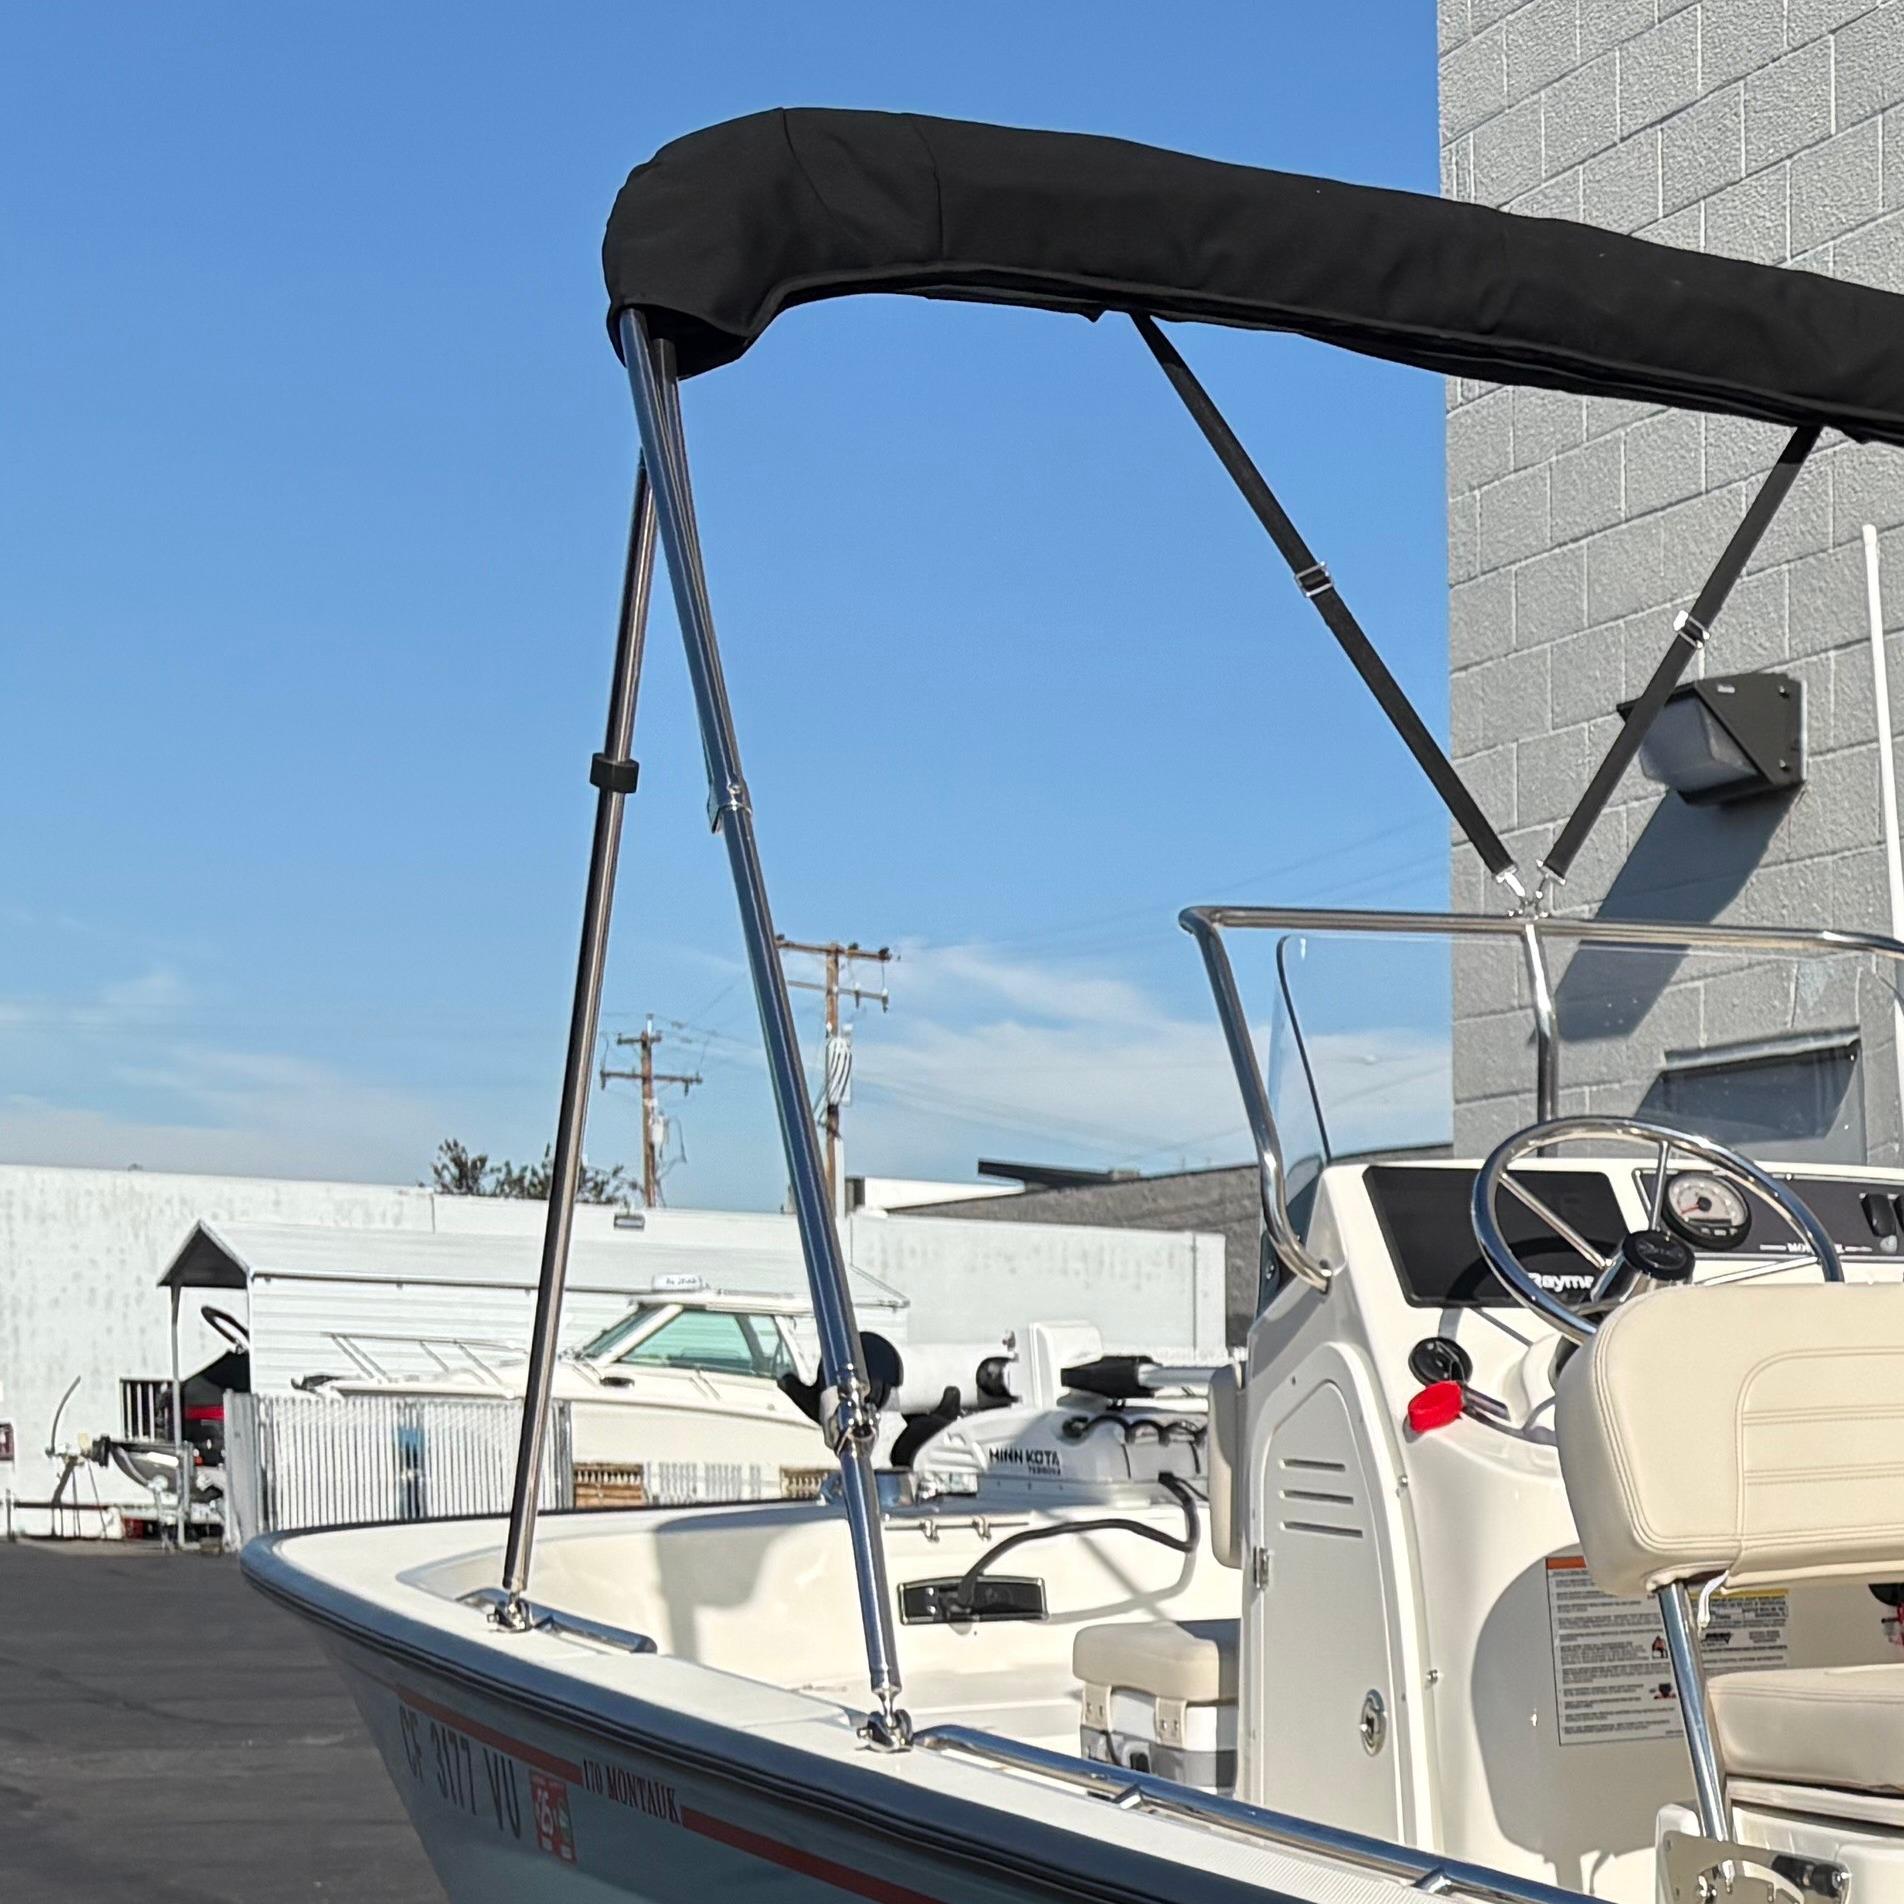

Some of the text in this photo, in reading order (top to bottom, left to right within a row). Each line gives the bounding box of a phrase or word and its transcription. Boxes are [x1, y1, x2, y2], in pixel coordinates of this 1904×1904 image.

[989, 1448, 1060, 1466] MINN KOTA
[583, 1757, 603, 1794] 170
[606, 1765, 681, 1824] MONTAUK
